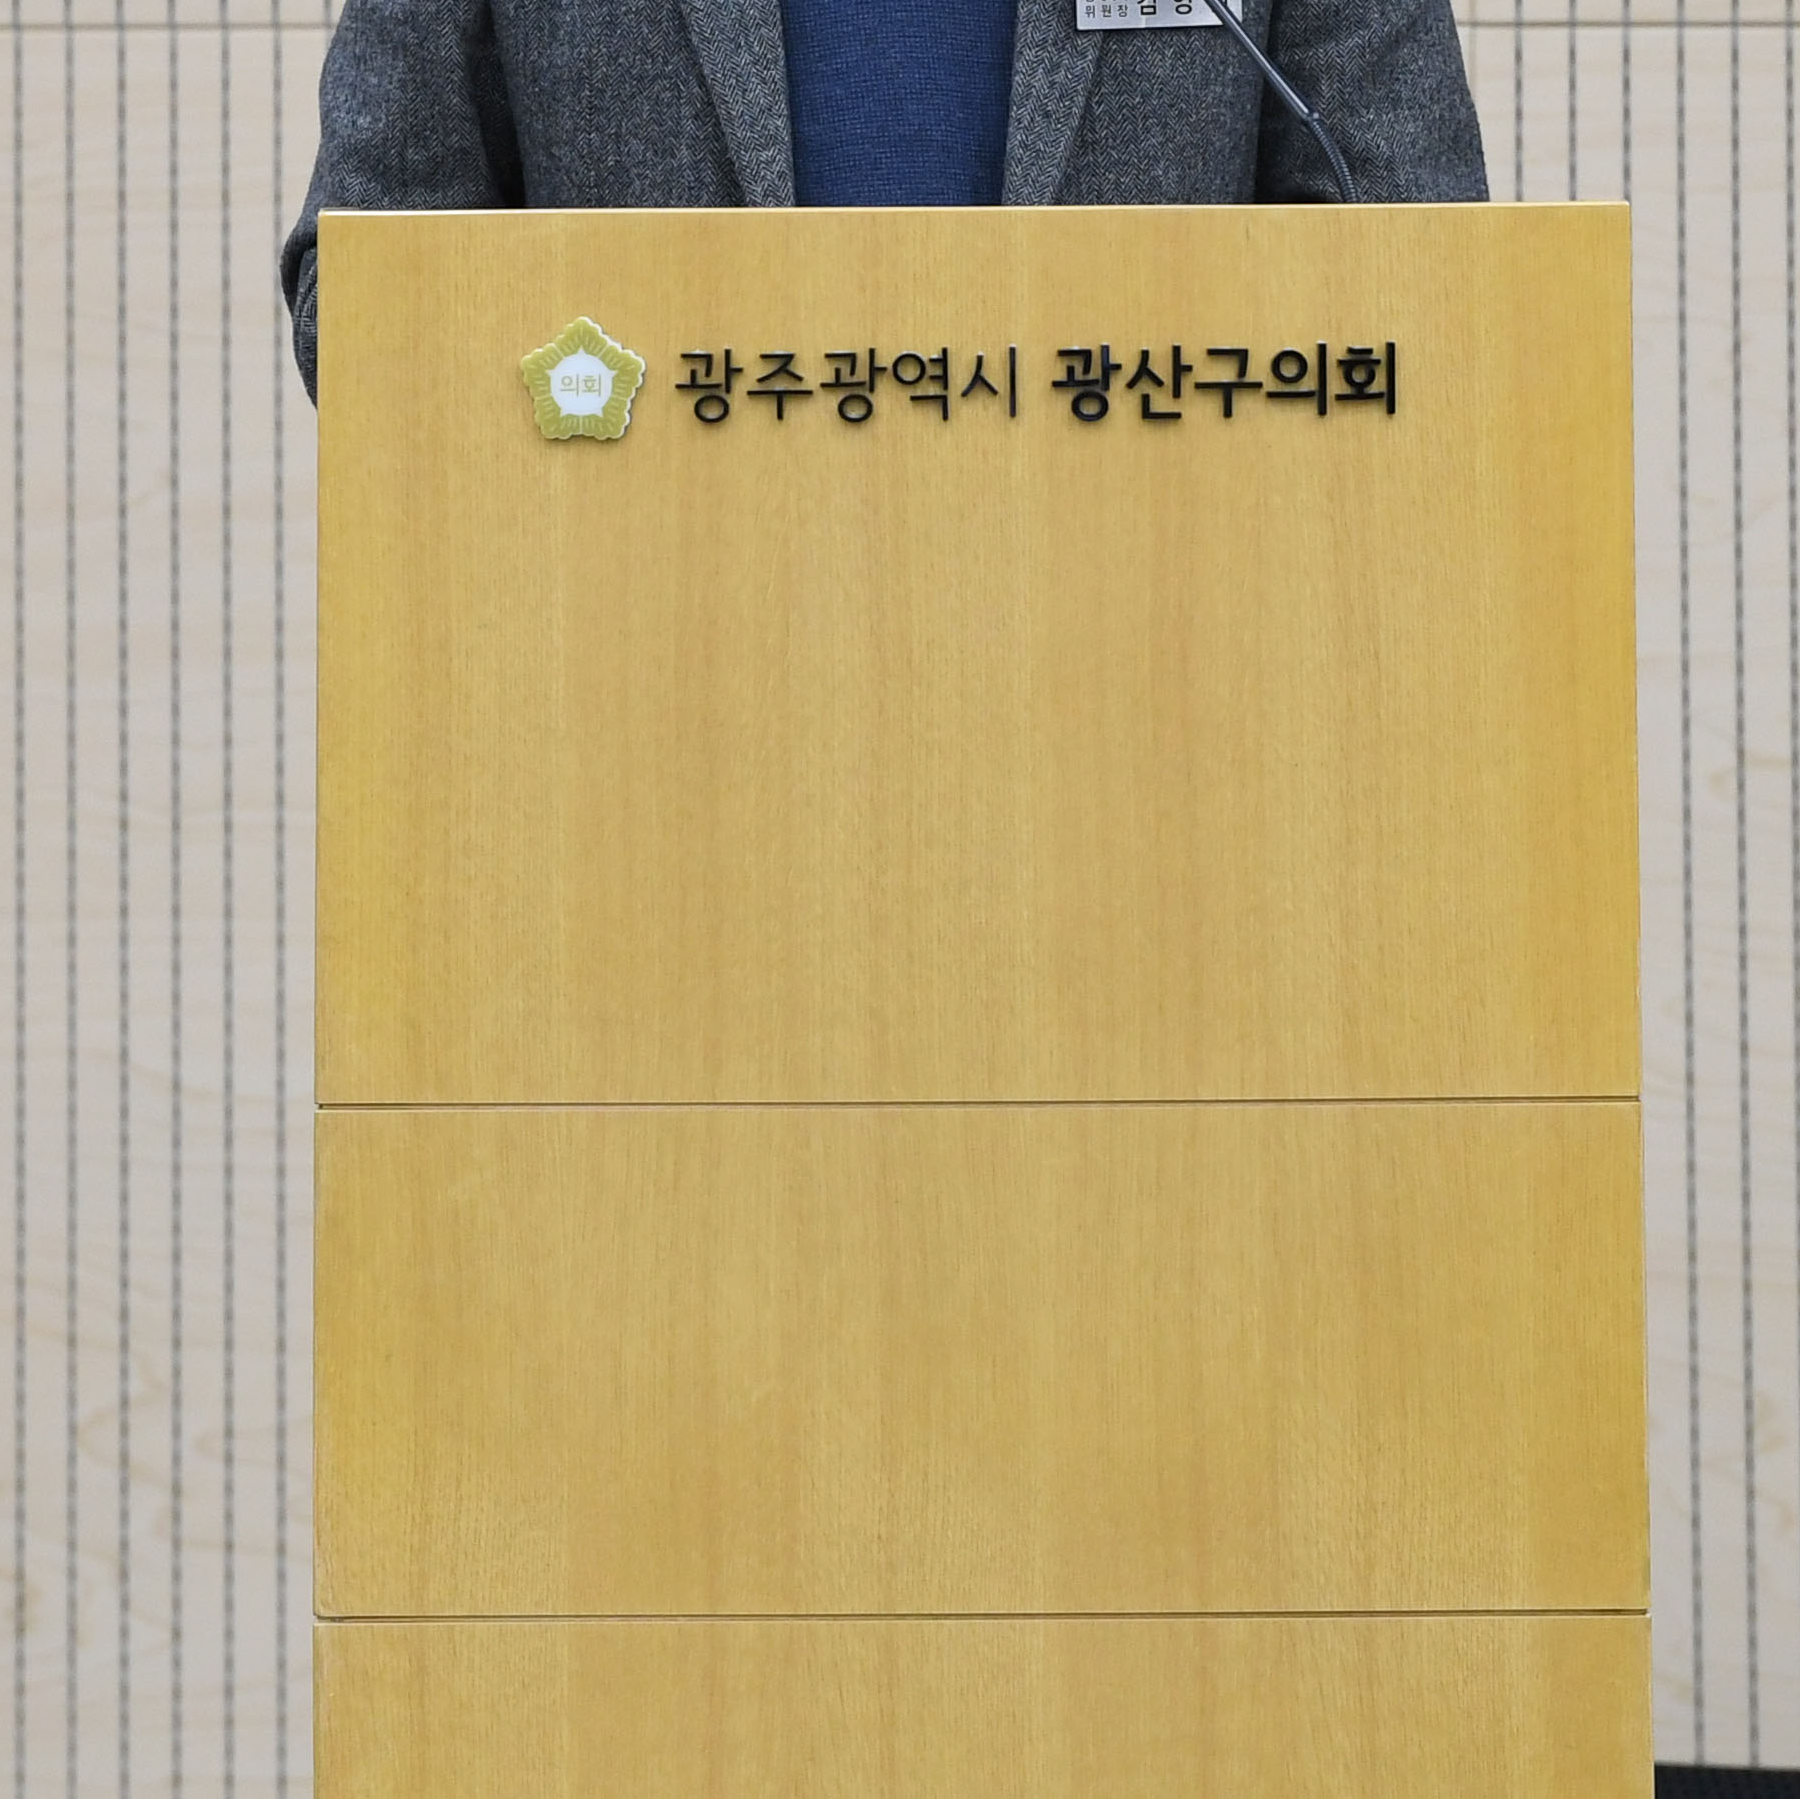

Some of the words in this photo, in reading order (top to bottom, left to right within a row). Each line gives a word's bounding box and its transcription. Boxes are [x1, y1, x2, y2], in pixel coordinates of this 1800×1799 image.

[559, 373, 602, 397] 의회
[674, 346, 1018, 424] 광주광역시
[1050, 341, 1397, 423] 광산구의회
